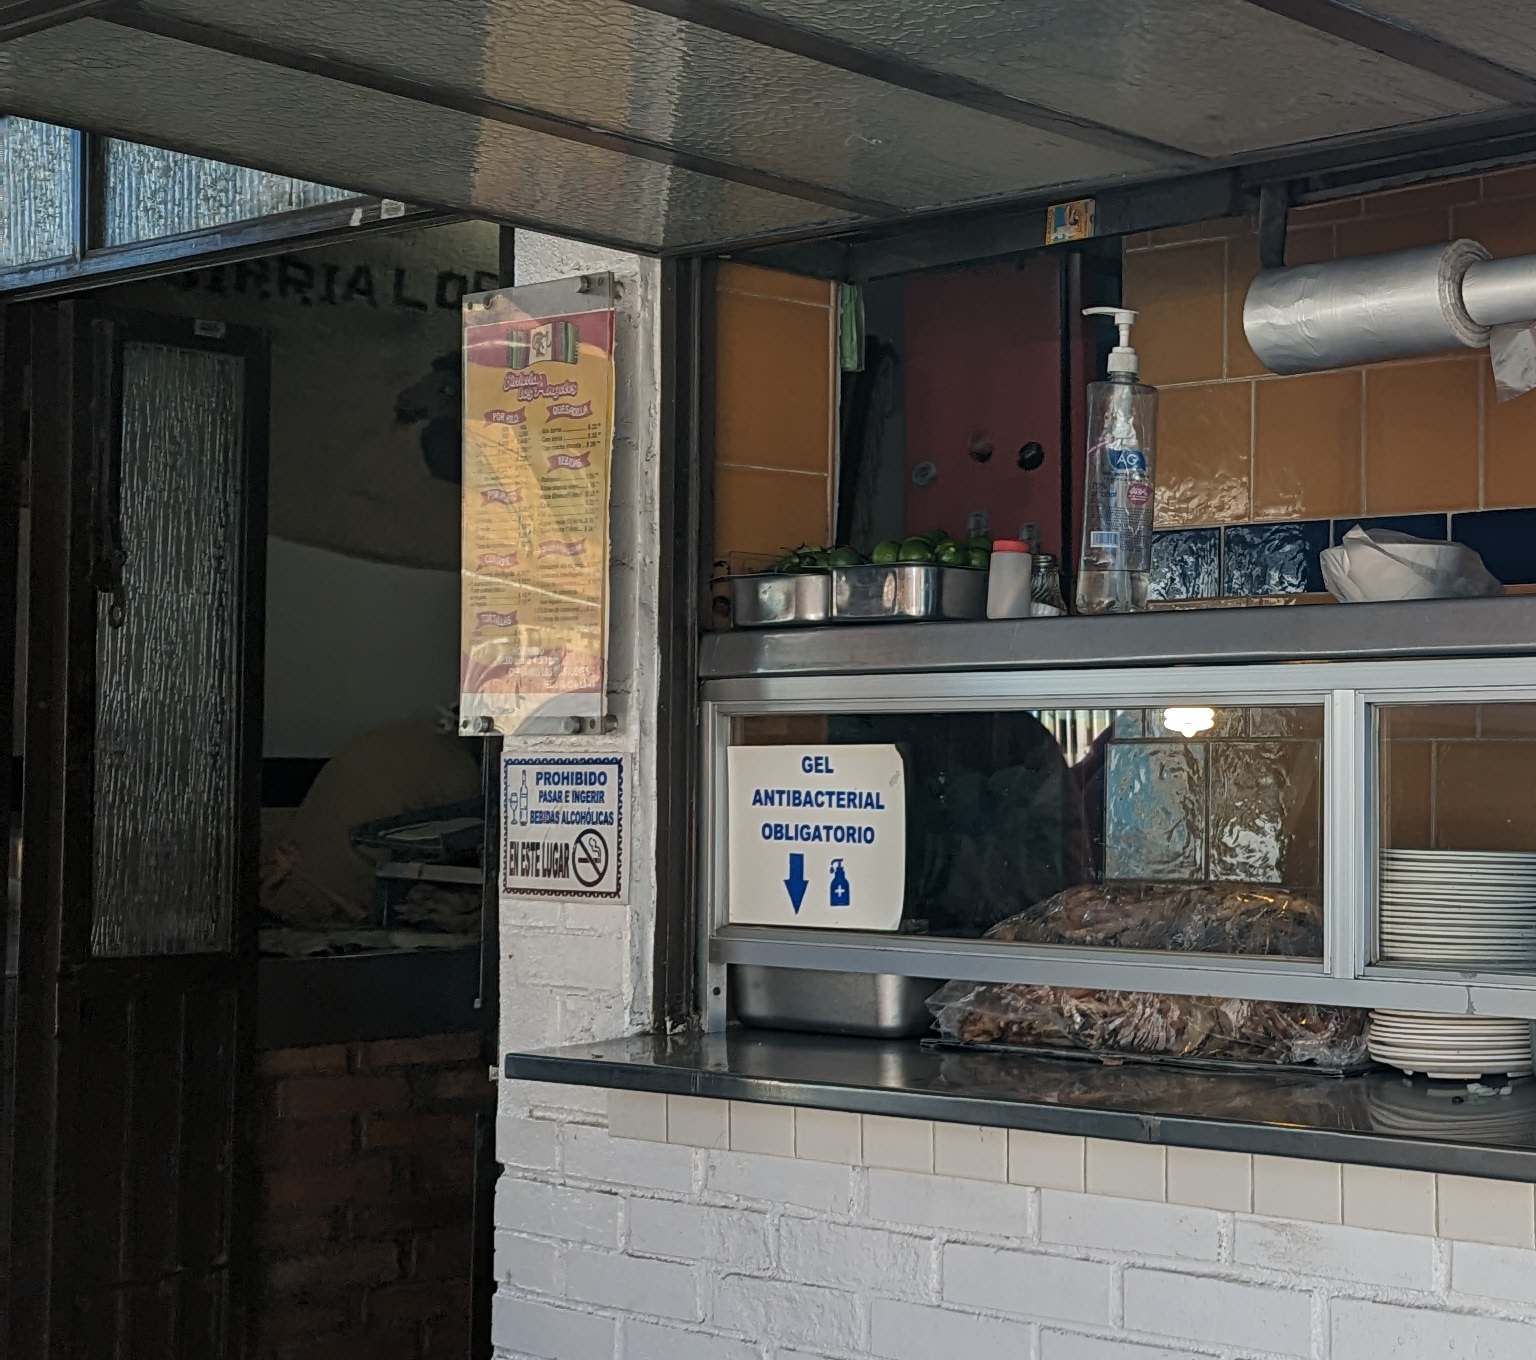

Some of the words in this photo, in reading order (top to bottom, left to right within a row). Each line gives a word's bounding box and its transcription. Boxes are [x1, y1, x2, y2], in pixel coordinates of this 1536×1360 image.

[1116, 453, 1139, 466] AG
[801, 755, 835, 775] GEL
[535, 770, 608, 787] PROHIBIDO
[538, 789, 563, 804] PASAR
[564, 790, 571, 804] E
[571, 789, 606, 805] INGERIR
[751, 788, 886, 811] ANTIBACTERIAL
[529, 809, 560, 826] BEBIDAS
[560, 806, 615, 827] ALCOHÓLICAS
[760, 822, 876, 845] OBLIGATORIO
[508, 840, 520, 878] EN
[520, 840, 541, 879] ESTE
[541, 840, 570, 880] LUGAR
